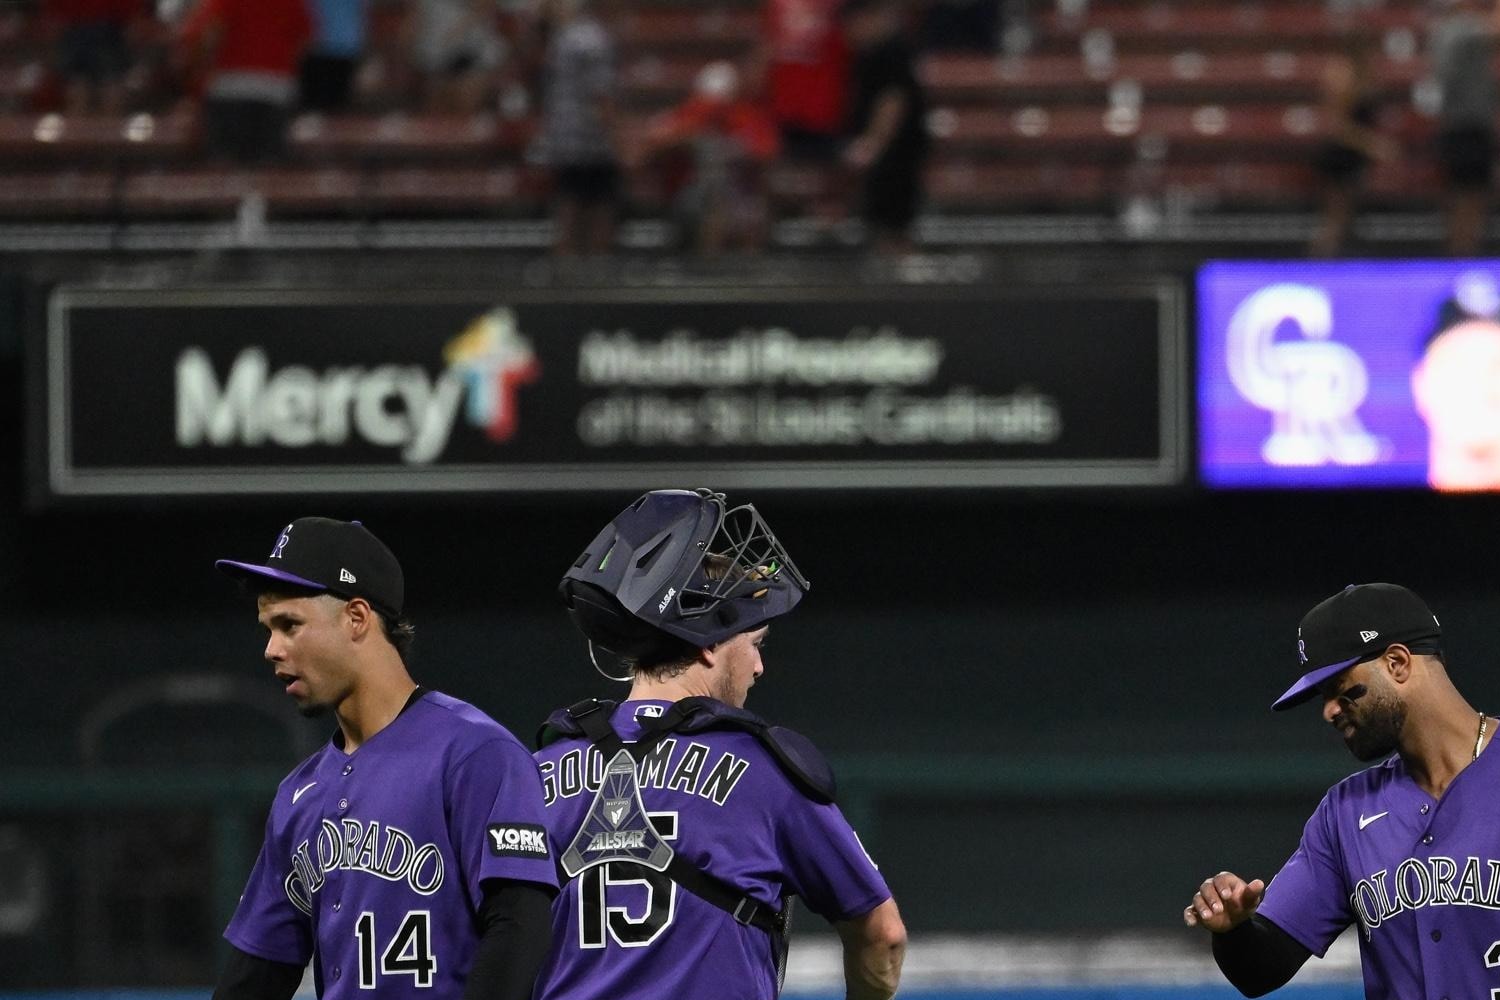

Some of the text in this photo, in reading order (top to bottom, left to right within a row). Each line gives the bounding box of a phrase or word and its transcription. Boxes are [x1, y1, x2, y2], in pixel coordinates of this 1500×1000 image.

[578, 326, 938, 386] Medical Provider
[174, 346, 468, 466] Mercy
[862, 384, 1063, 446] Cardinals
[489, 828, 548, 854] YORK
[577, 810, 679, 949] 15
[354, 910, 437, 990] 14
